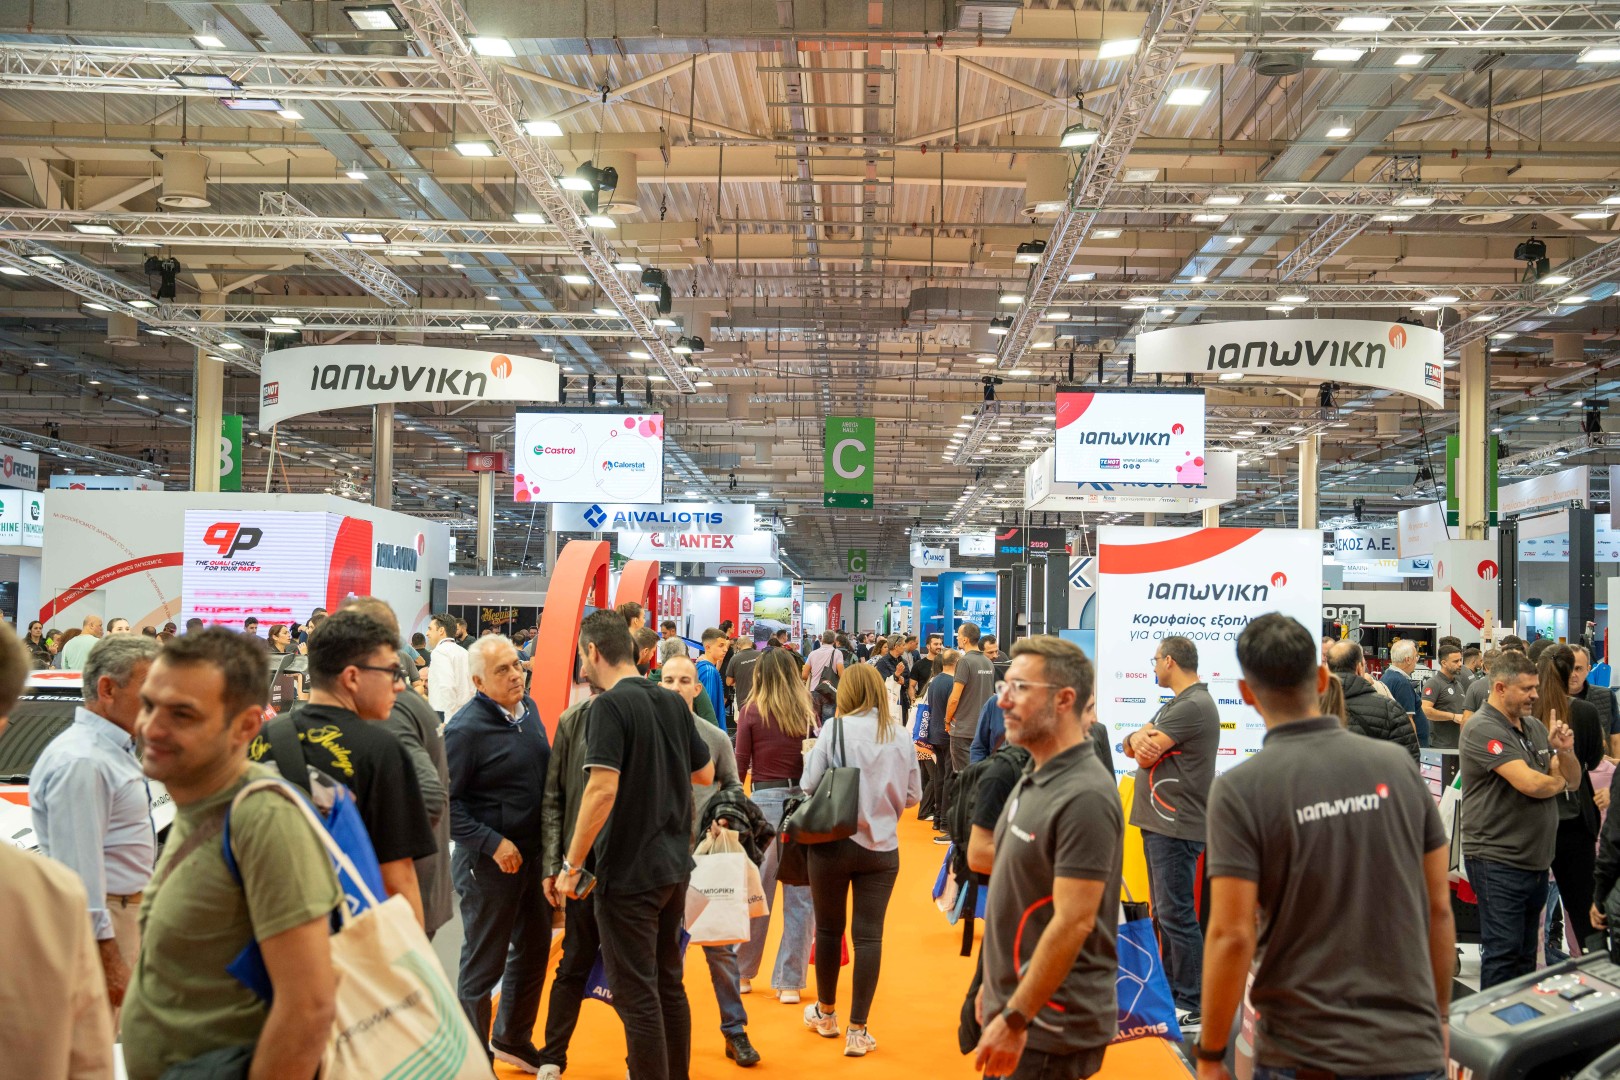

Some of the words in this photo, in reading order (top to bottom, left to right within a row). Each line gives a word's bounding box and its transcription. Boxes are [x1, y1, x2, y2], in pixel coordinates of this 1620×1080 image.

[832, 438, 866, 478] C
[614, 511, 723, 524] AIVALIOTIS
[850, 557, 864, 571] C
[1132, 613, 1206, 627] Κορυφαίος
[1130, 630, 1149, 641] για
[1224, 632, 1240, 641] συ
[1112, 1022, 1168, 1042] ALIOTIS
